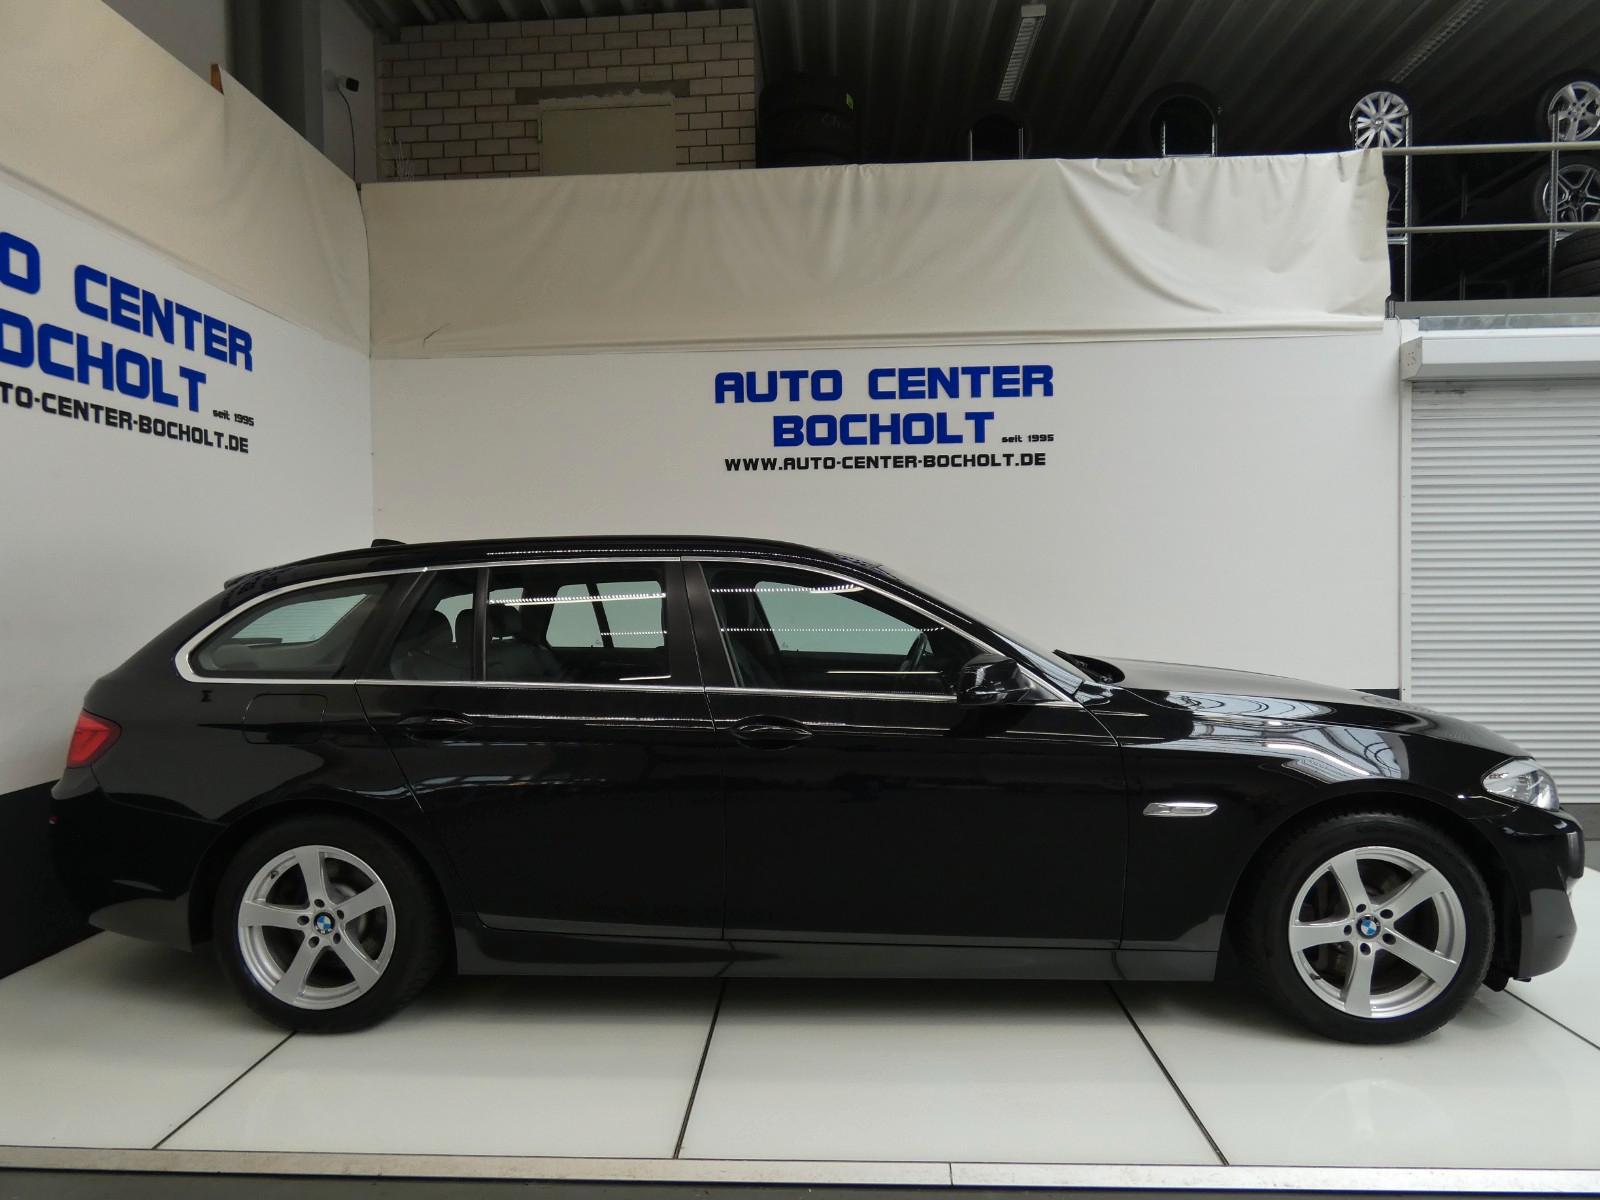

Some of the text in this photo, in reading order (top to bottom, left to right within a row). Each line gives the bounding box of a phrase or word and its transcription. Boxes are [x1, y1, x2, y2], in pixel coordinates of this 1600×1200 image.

[74, 264, 253, 372] CENTER
[714, 365, 1054, 404] AUTO CENTER
[212, 409, 255, 427] seit 1995
[773, 411, 995, 447] BOCHOLT
[1001, 433, 1055, 444] seit 1995
[724, 452, 1046, 472] WWW.AUTO-CENTER-BOCHOLT.DE
